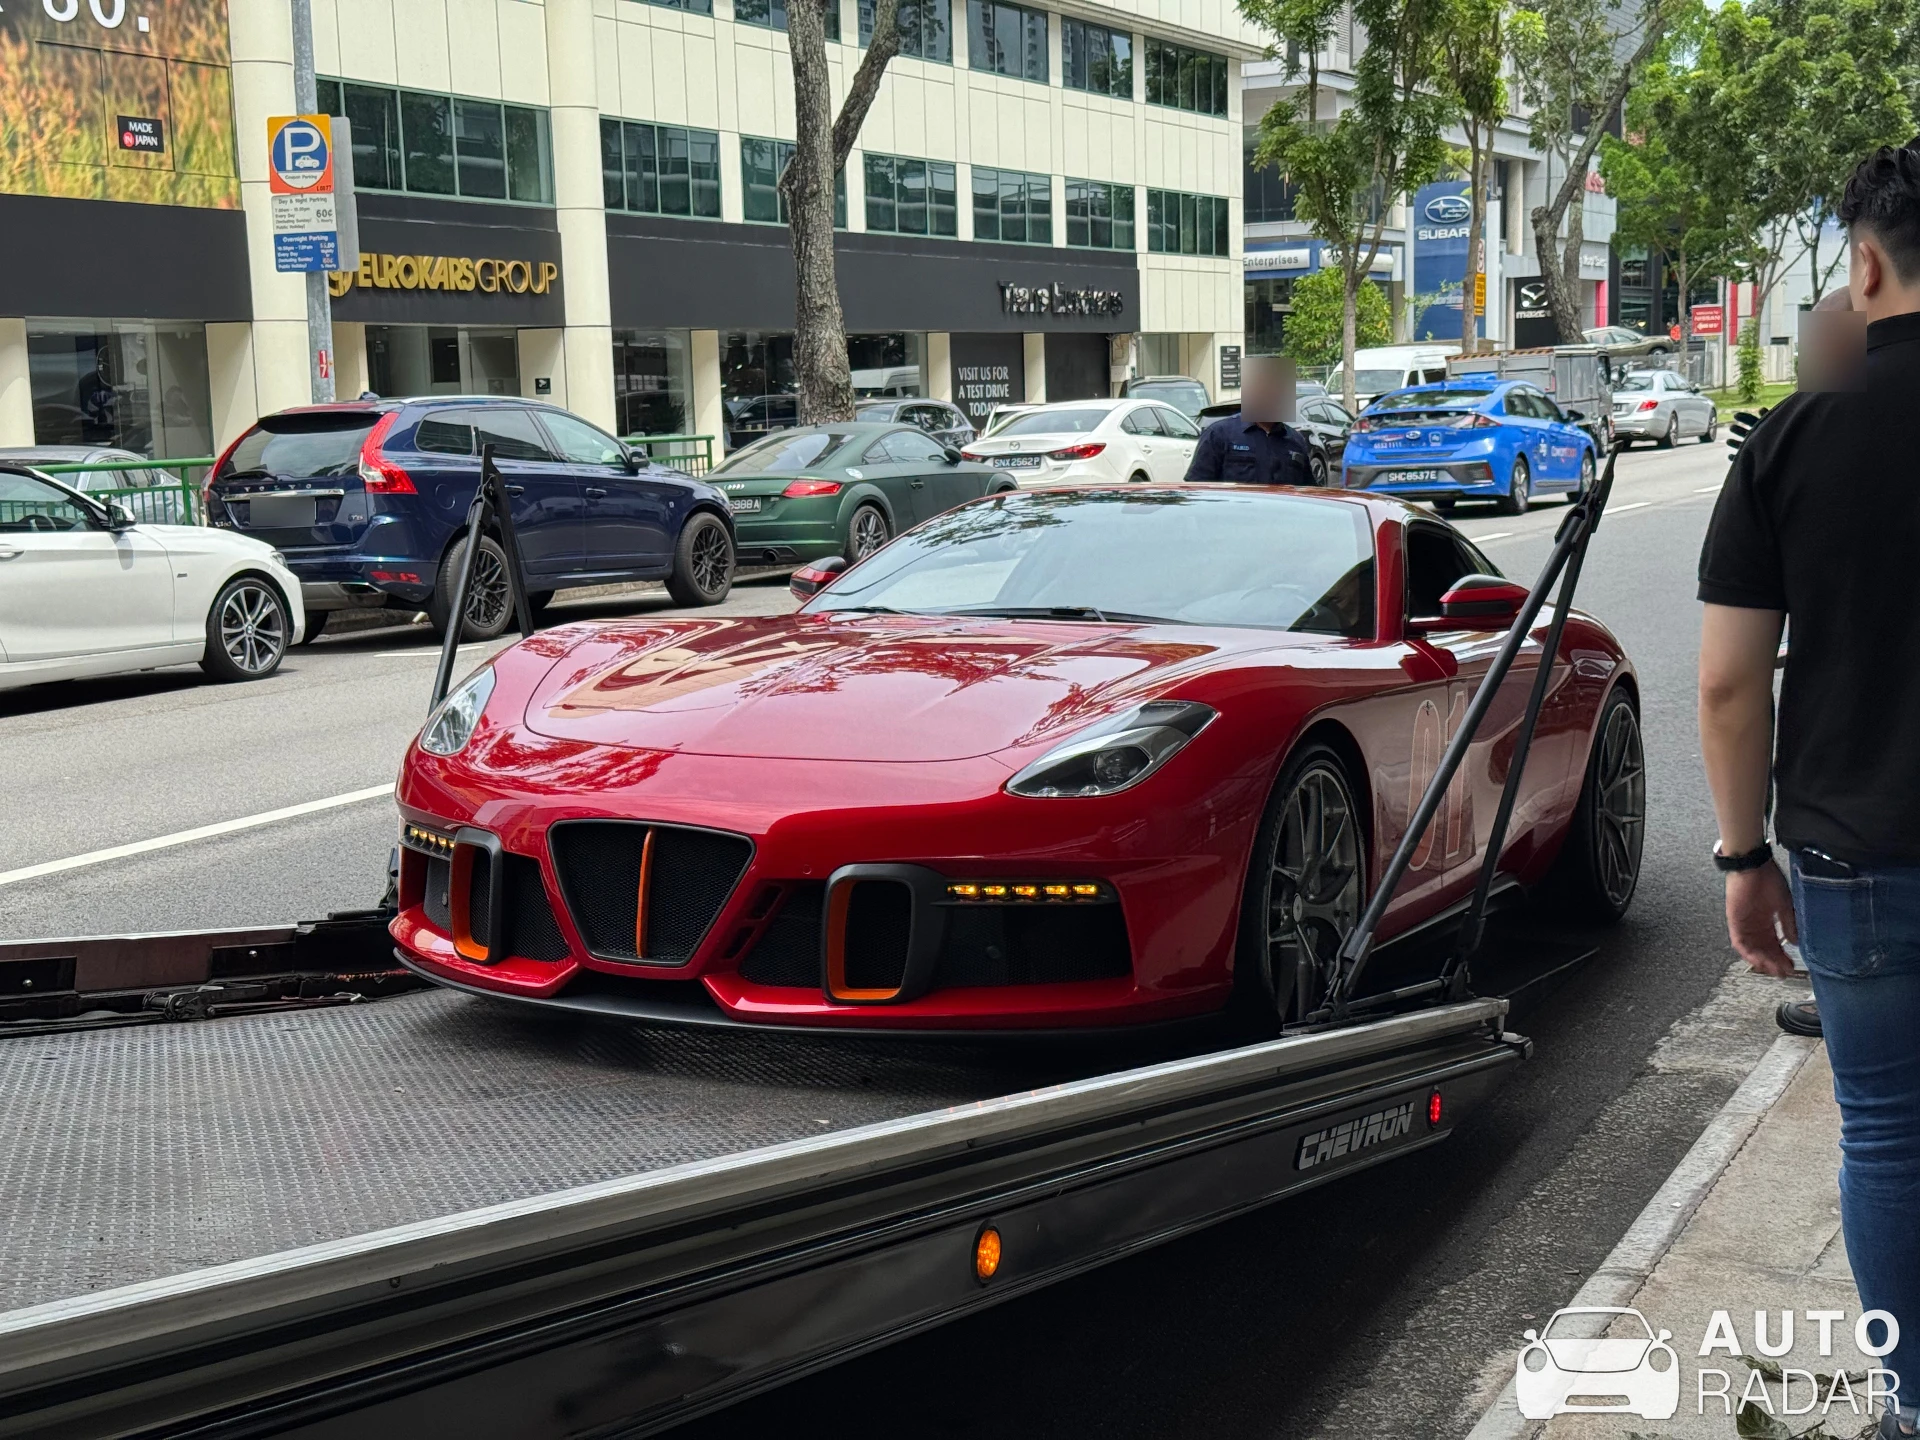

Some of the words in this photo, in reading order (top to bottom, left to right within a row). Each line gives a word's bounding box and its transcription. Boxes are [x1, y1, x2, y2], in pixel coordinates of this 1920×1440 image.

[128, 121, 153, 133] MADE
[135, 135, 158, 146] JAPAN
[284, 127, 321, 171] P
[1418, 227, 1470, 241] SUBAR
[1243, 255, 1299, 267] Enterprises
[958, 367, 979, 381] VISIT
[980, 367, 991, 381] US
[992, 366, 1009, 380] FOR
[958, 385, 966, 399] A
[966, 384, 984, 399] TEST
[985, 383, 1010, 398] DRIVE
[244, 483, 312, 492] VOLVO
[1298, 1101, 1415, 1170] CHEVRON
